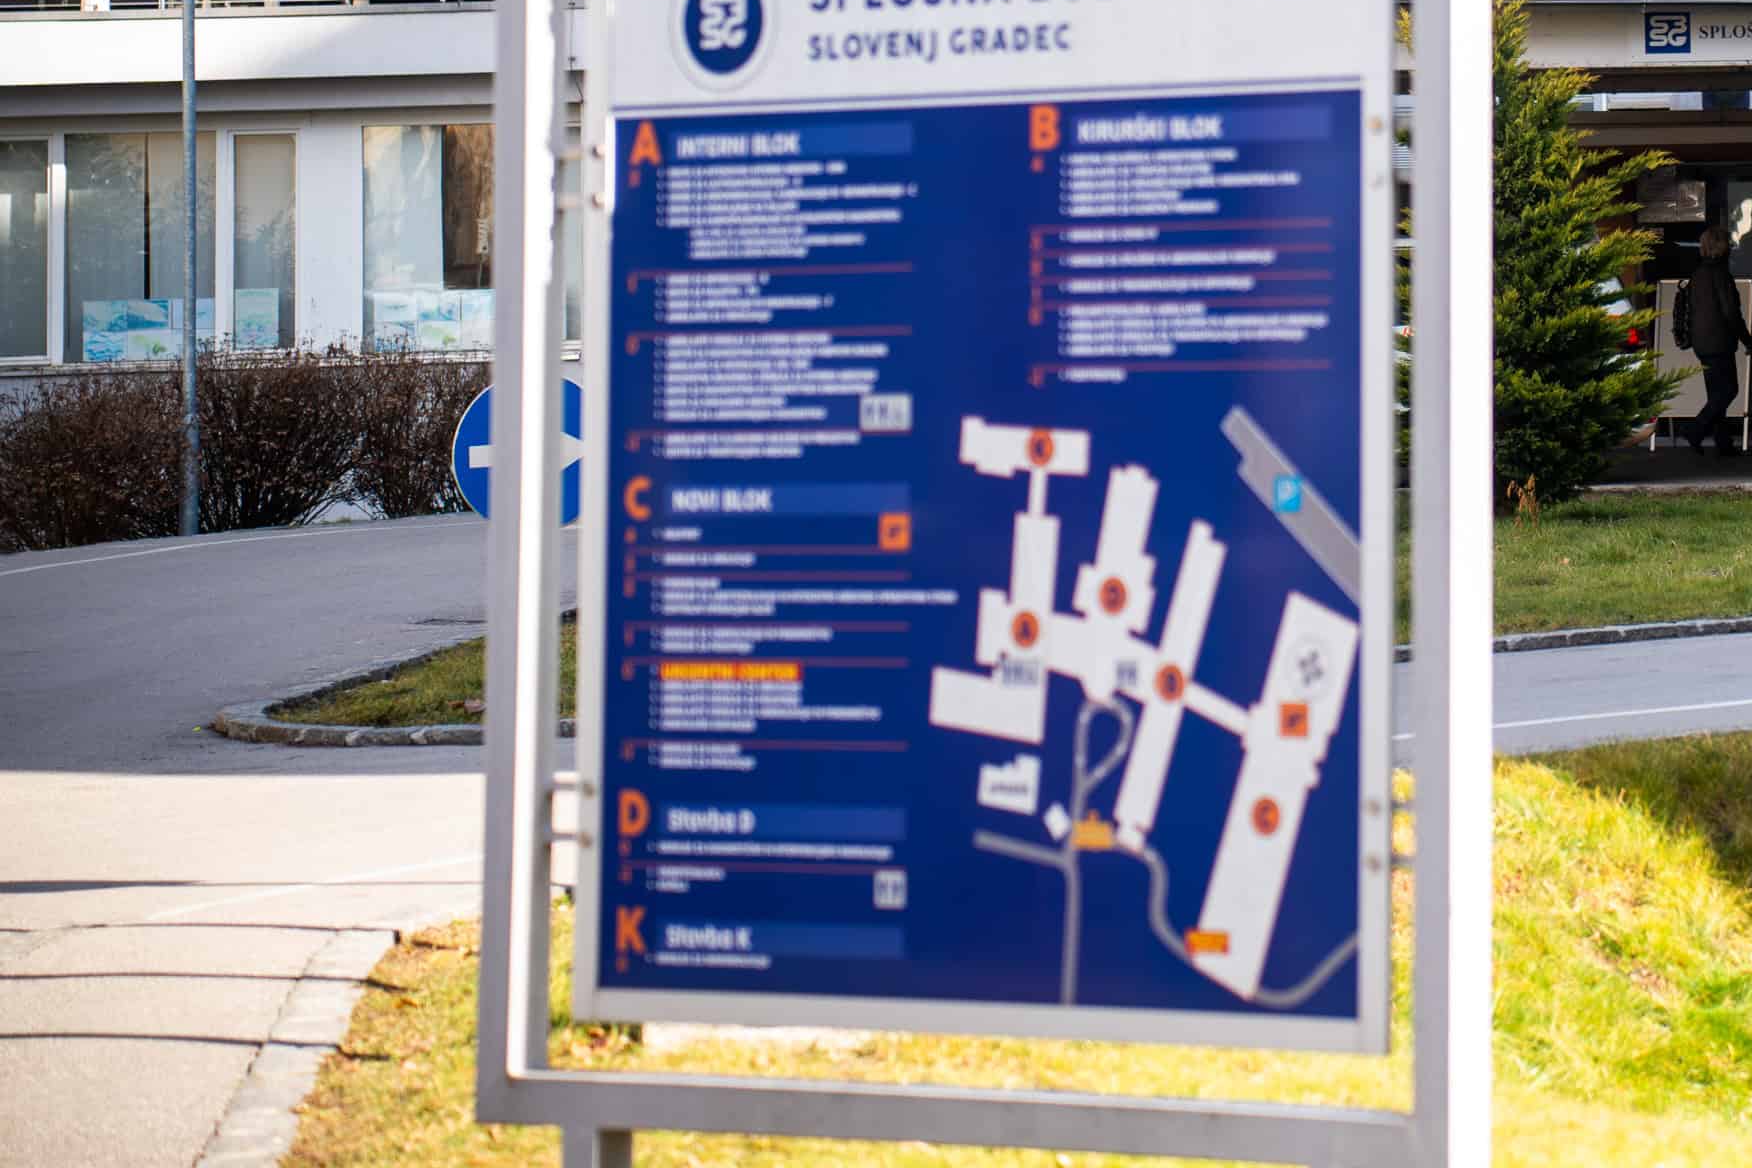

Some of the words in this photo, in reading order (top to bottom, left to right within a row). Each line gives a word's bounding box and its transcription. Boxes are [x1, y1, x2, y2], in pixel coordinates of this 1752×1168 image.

[808, 30, 939, 63] SLOVENJ
[949, 22, 1070, 56] GRADEC
[630, 121, 661, 164] A
[1029, 104, 1060, 150] B
[624, 475, 650, 520] C
[619, 790, 649, 836] D
[616, 907, 645, 952] K
